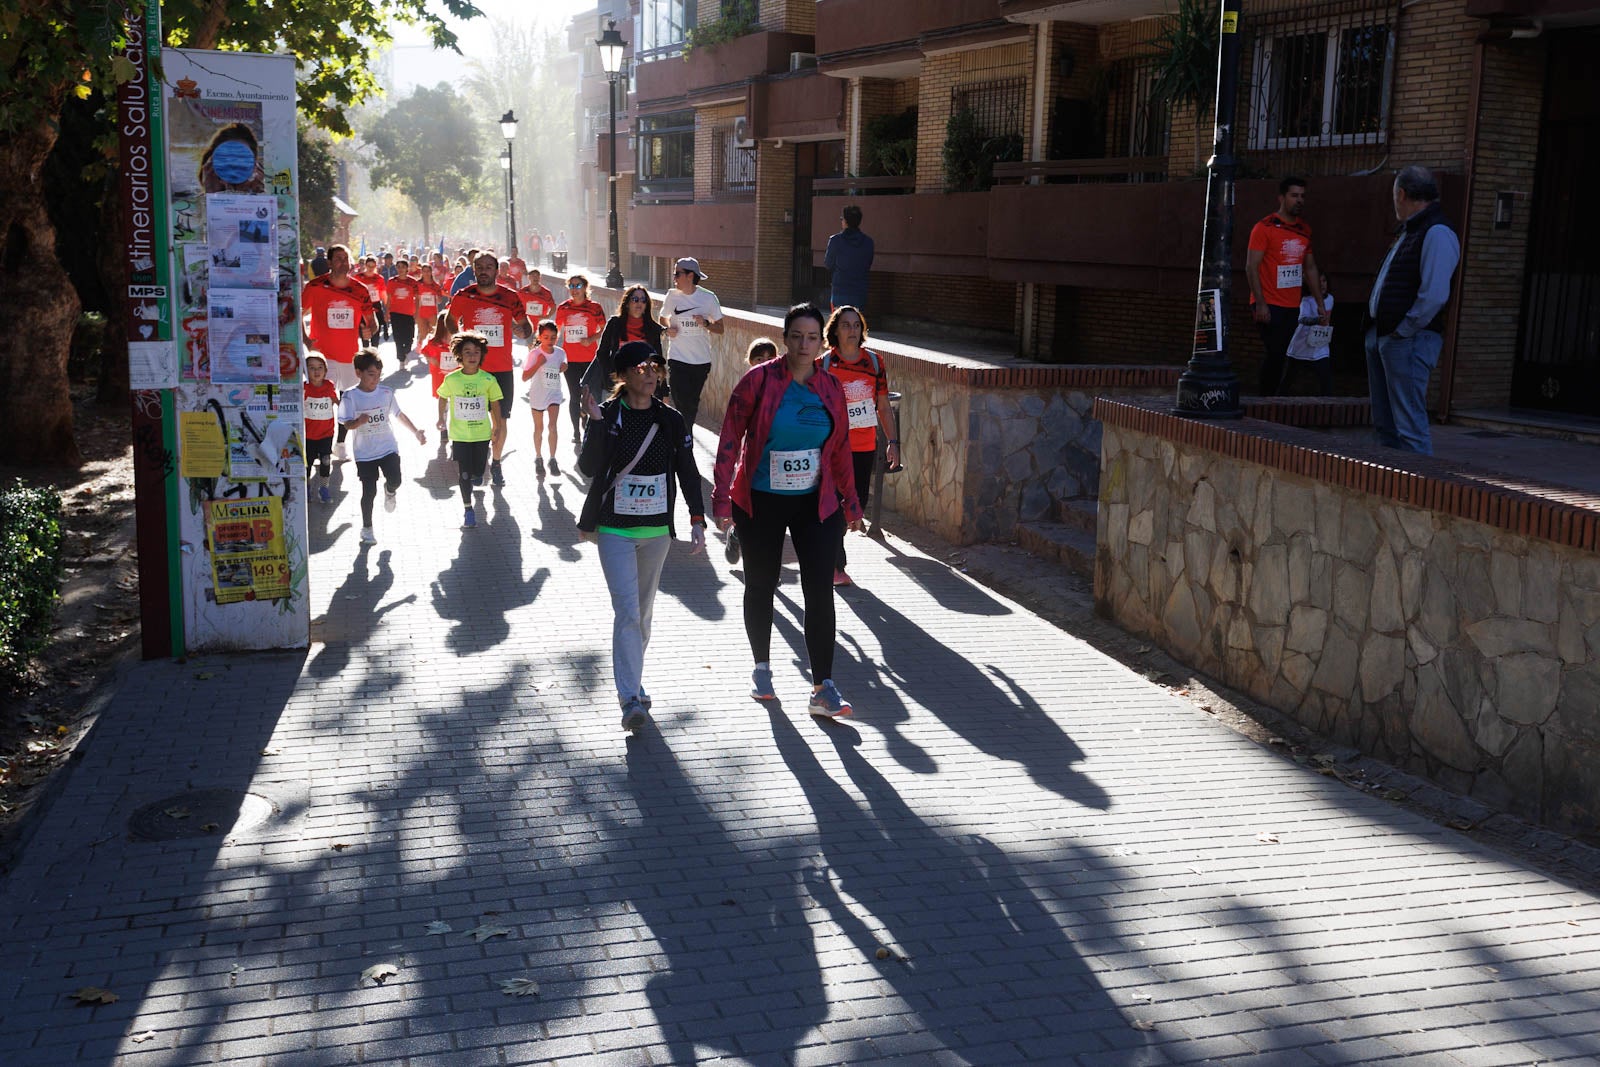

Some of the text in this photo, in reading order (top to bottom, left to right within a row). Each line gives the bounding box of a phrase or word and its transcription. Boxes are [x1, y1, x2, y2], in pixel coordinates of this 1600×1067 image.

[149, 45, 157, 56] de
[206, 88, 289, 101] Excmo. Ayuntamiento
[152, 96, 160, 118] Ruta
[128, 145, 150, 263] Itinerarios
[1282, 269, 1299, 278] 1715
[130, 287, 165, 297] MPS
[309, 402, 329, 410] 1760
[460, 401, 481, 410] 1759
[849, 406, 867, 417] 591
[368, 413, 385, 424] 066
[783, 458, 810, 472] 633
[628, 484, 656, 497] 776
[253, 519, 275, 543] B
[253, 563, 287, 577] 149 €
